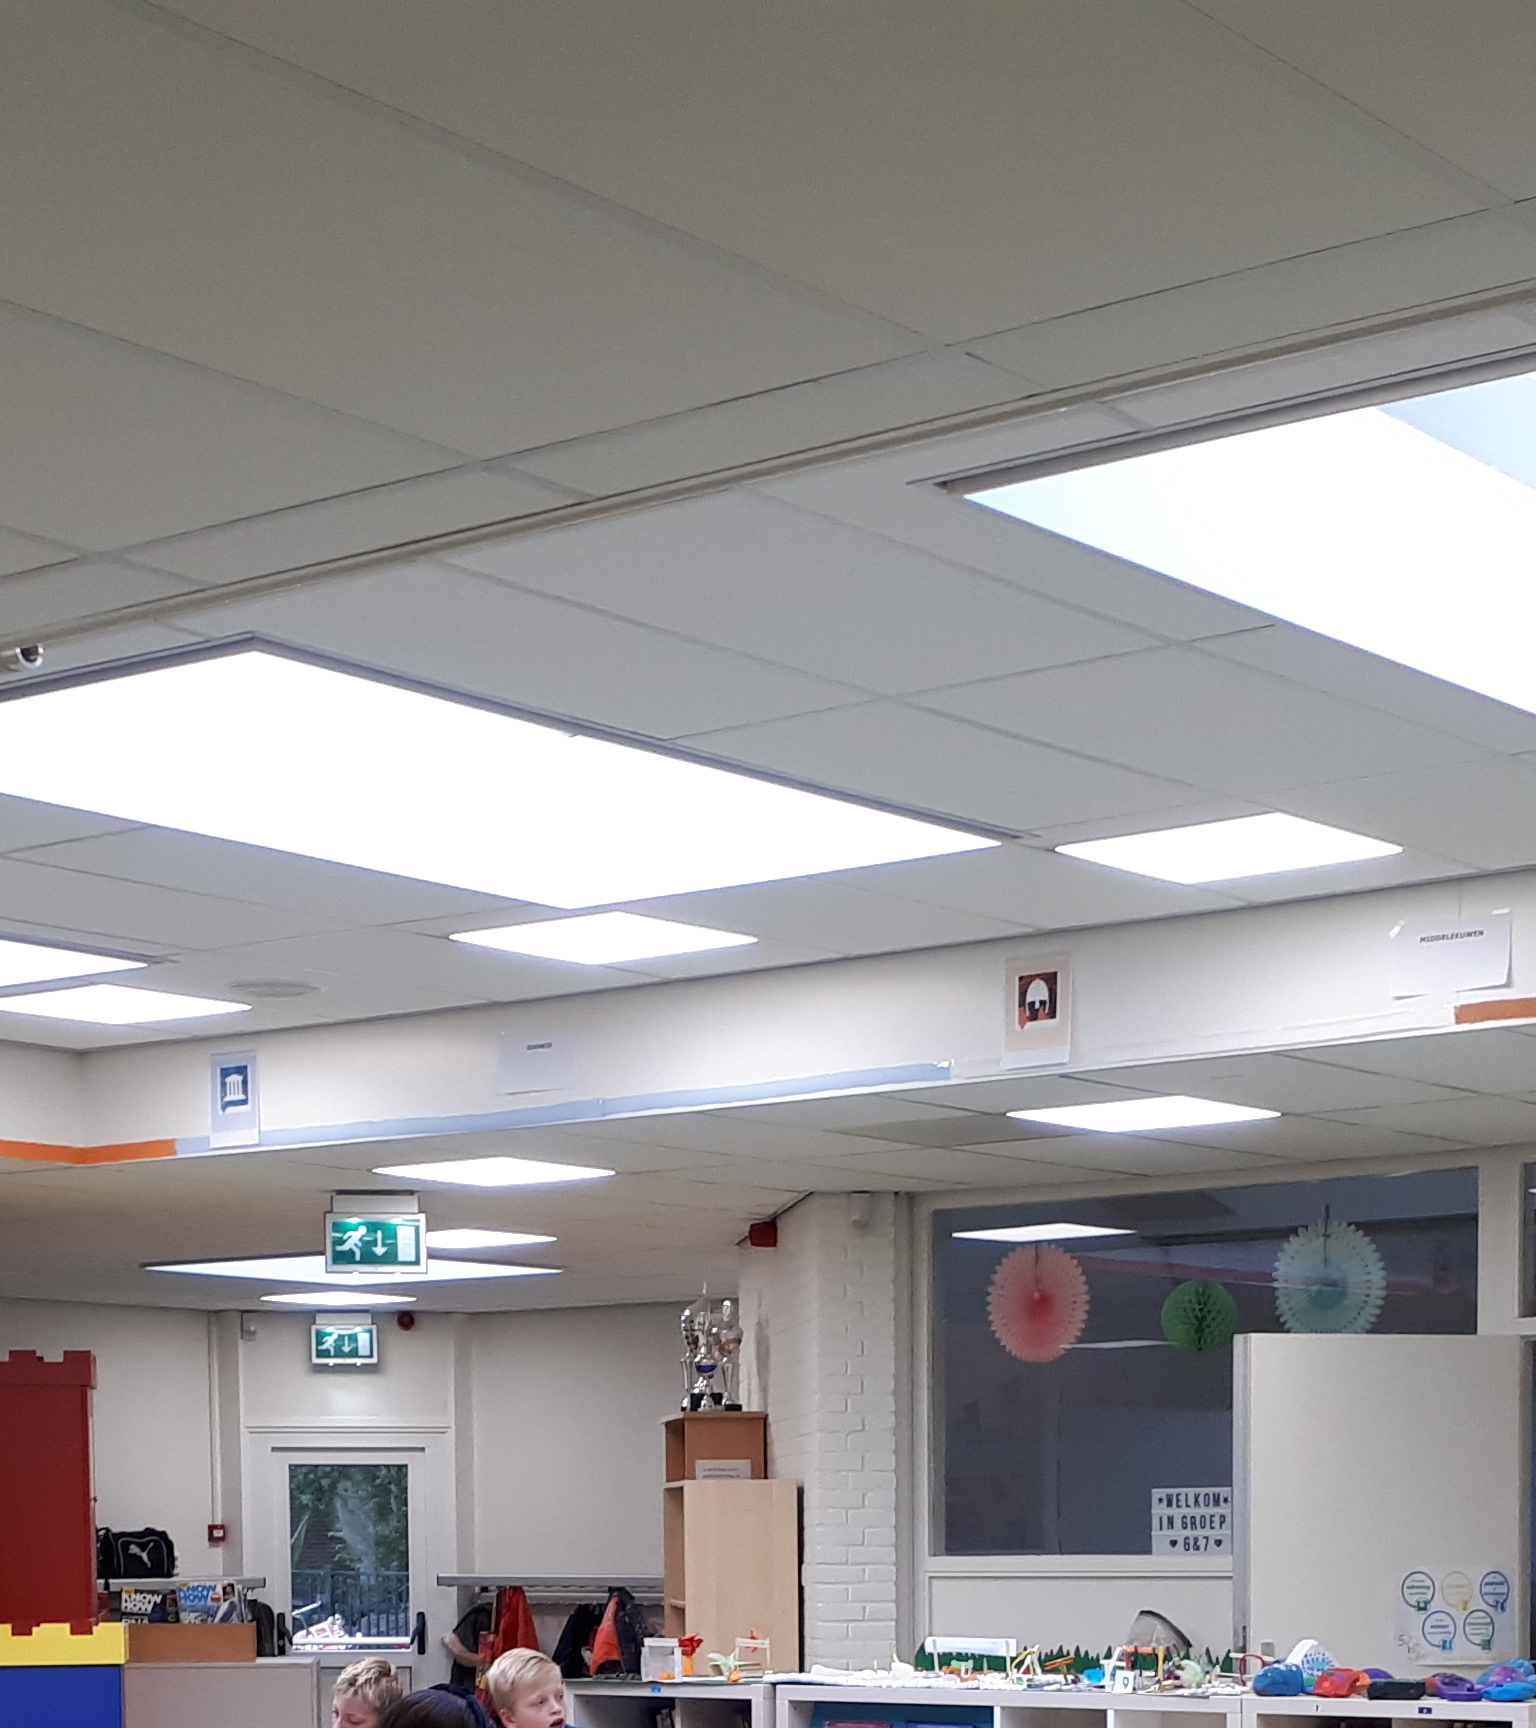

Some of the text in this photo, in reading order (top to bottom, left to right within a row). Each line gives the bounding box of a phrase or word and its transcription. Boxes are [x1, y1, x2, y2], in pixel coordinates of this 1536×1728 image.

[1165, 1492, 1221, 1509] WELKOM
[1158, 1513, 1227, 1531] IN GROEP
[1183, 1535, 1210, 1552] 6&7
